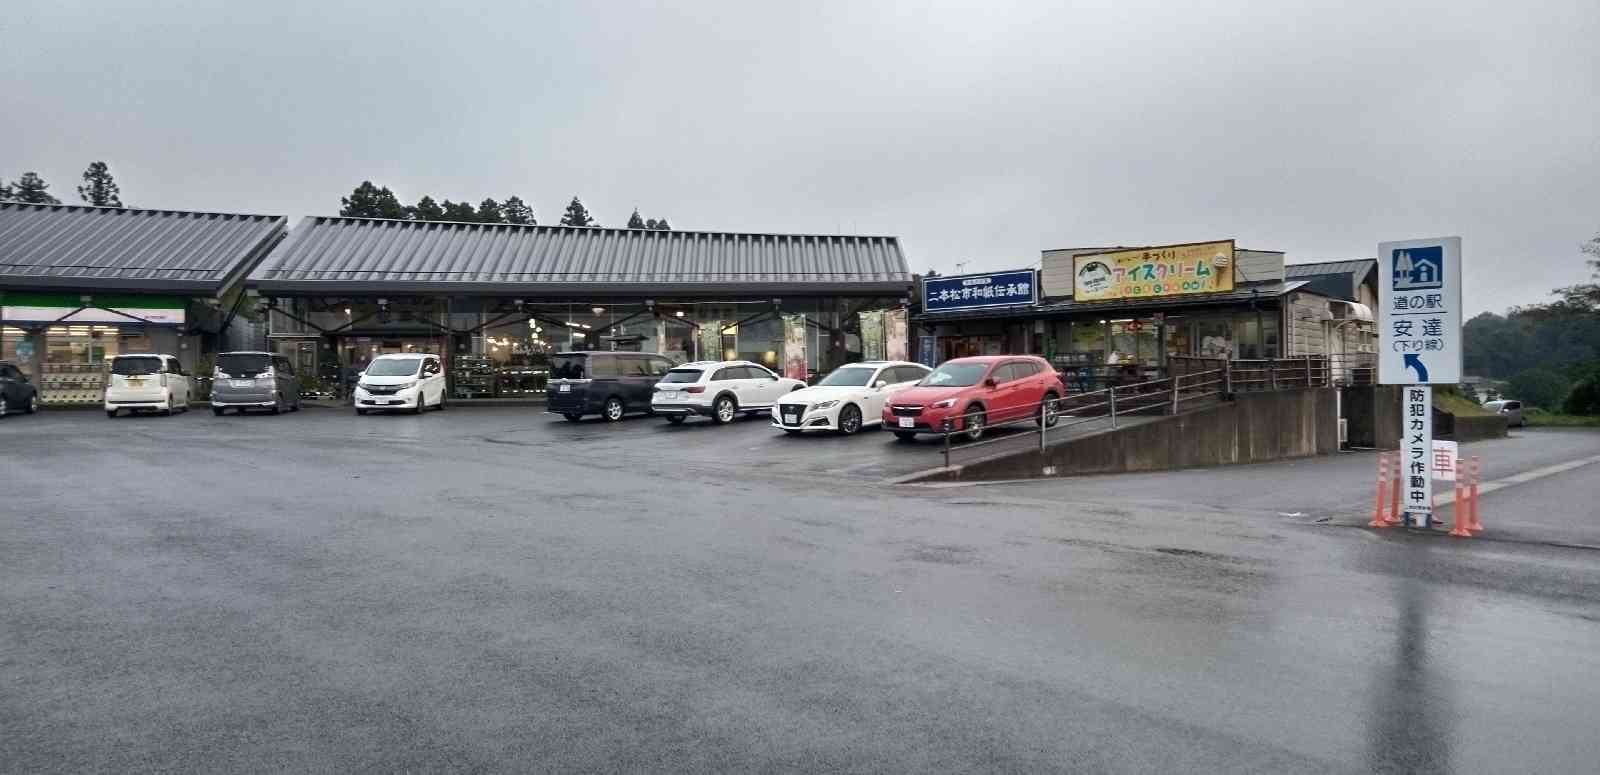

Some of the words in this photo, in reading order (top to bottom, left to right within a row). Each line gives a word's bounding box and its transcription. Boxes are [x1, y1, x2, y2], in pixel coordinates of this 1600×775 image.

[1112, 261, 1211, 283] アイスクリーム
[928, 283, 1030, 302] 二本松市和紙伝承館
[1393, 293, 1442, 310] 道の駅
[1393, 318, 1442, 337] 安達
[1409, 389, 1425, 503] 防犯カメラ作動中
